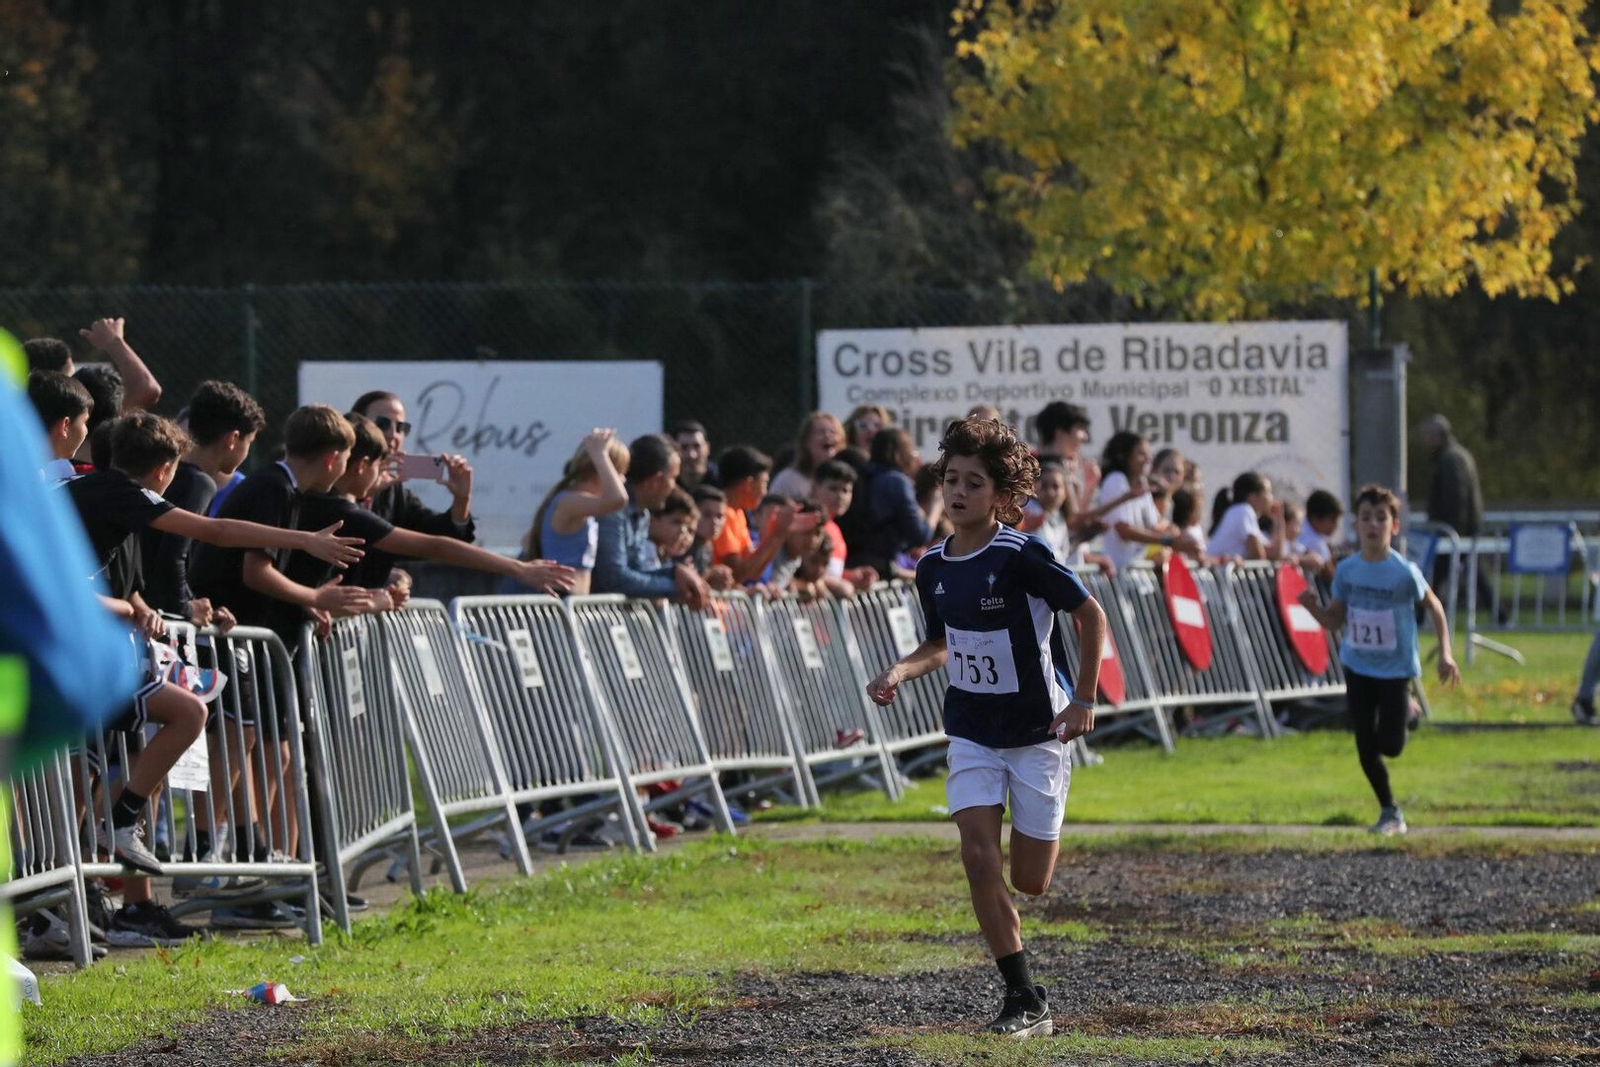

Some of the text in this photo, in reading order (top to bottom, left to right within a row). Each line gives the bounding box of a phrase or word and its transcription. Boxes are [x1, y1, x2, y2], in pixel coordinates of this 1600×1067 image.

[833, 335, 1328, 377] Cross Vila de Ribadavia
[847, 384, 957, 404] Complexo
[965, 381, 1074, 403] Deportivo
[1083, 379, 1189, 401] Municipal
[414, 374, 552, 456] Rebus
[1110, 404, 1290, 444] Veronza
[1351, 622, 1383, 645] 121
[954, 651, 999, 685] 753
